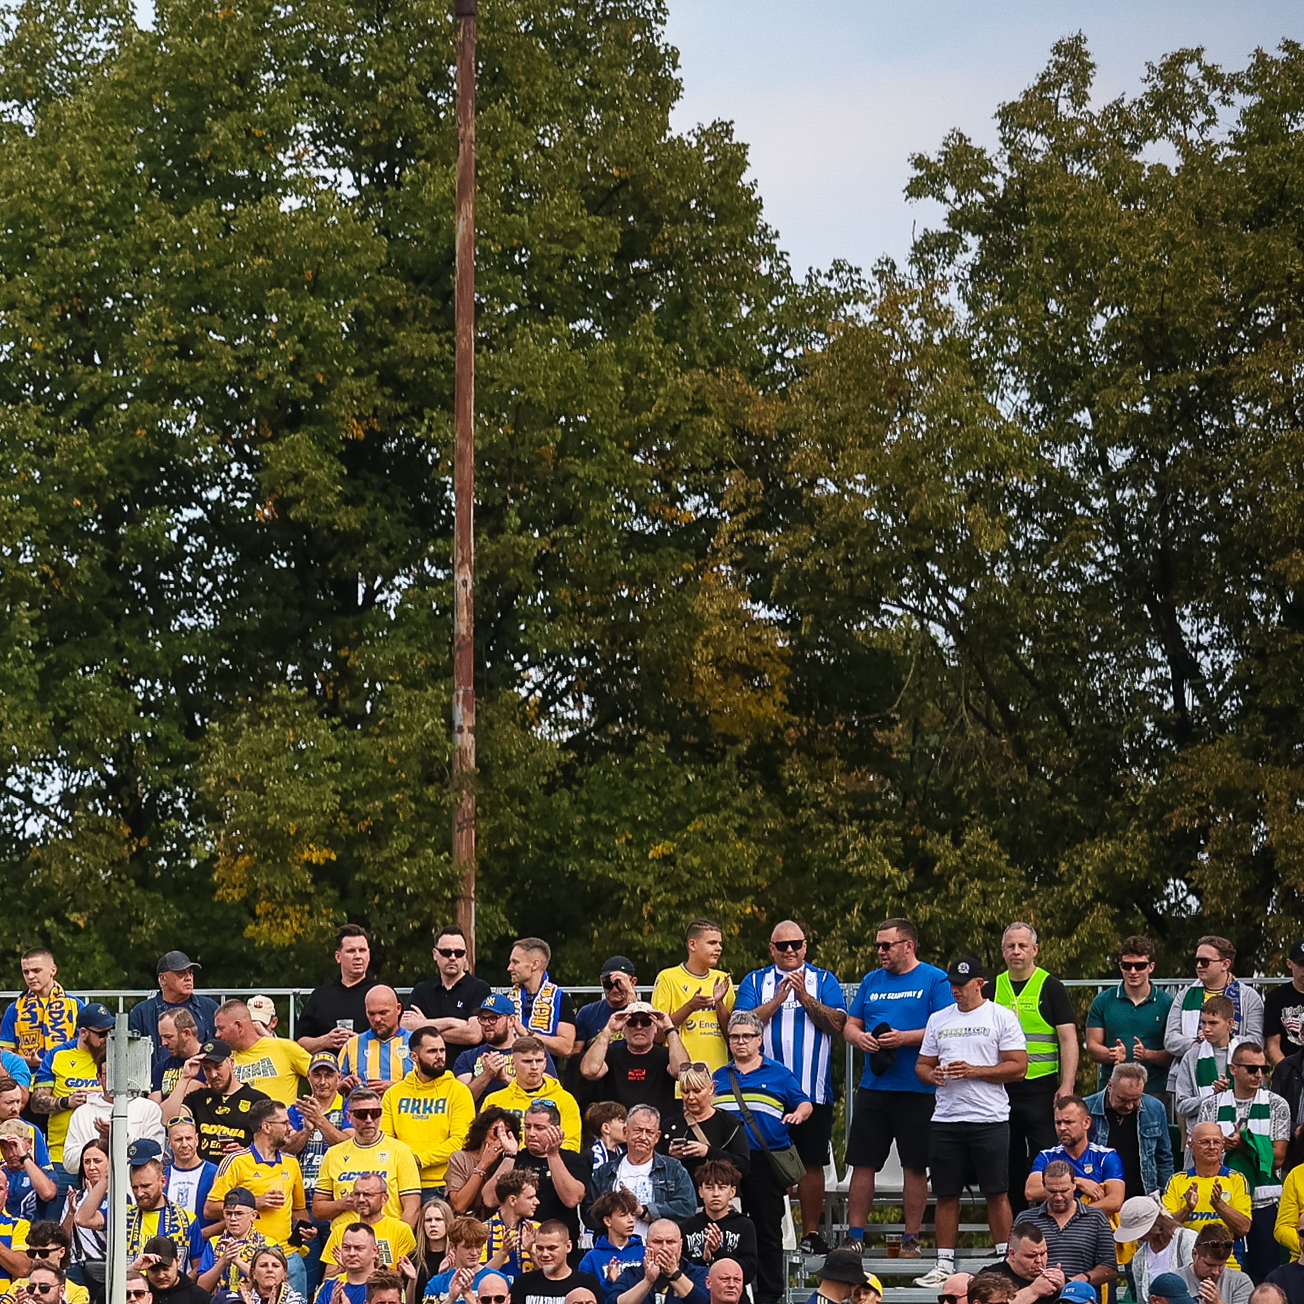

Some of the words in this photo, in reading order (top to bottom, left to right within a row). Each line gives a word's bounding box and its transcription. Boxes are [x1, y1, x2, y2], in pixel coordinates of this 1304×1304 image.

[313, 1053, 335, 1062] ARKA
[66, 1077, 101, 1088] GDYN
[398, 1096, 447, 1115] ARKA
[200, 1122, 245, 1140] GDYNIA
